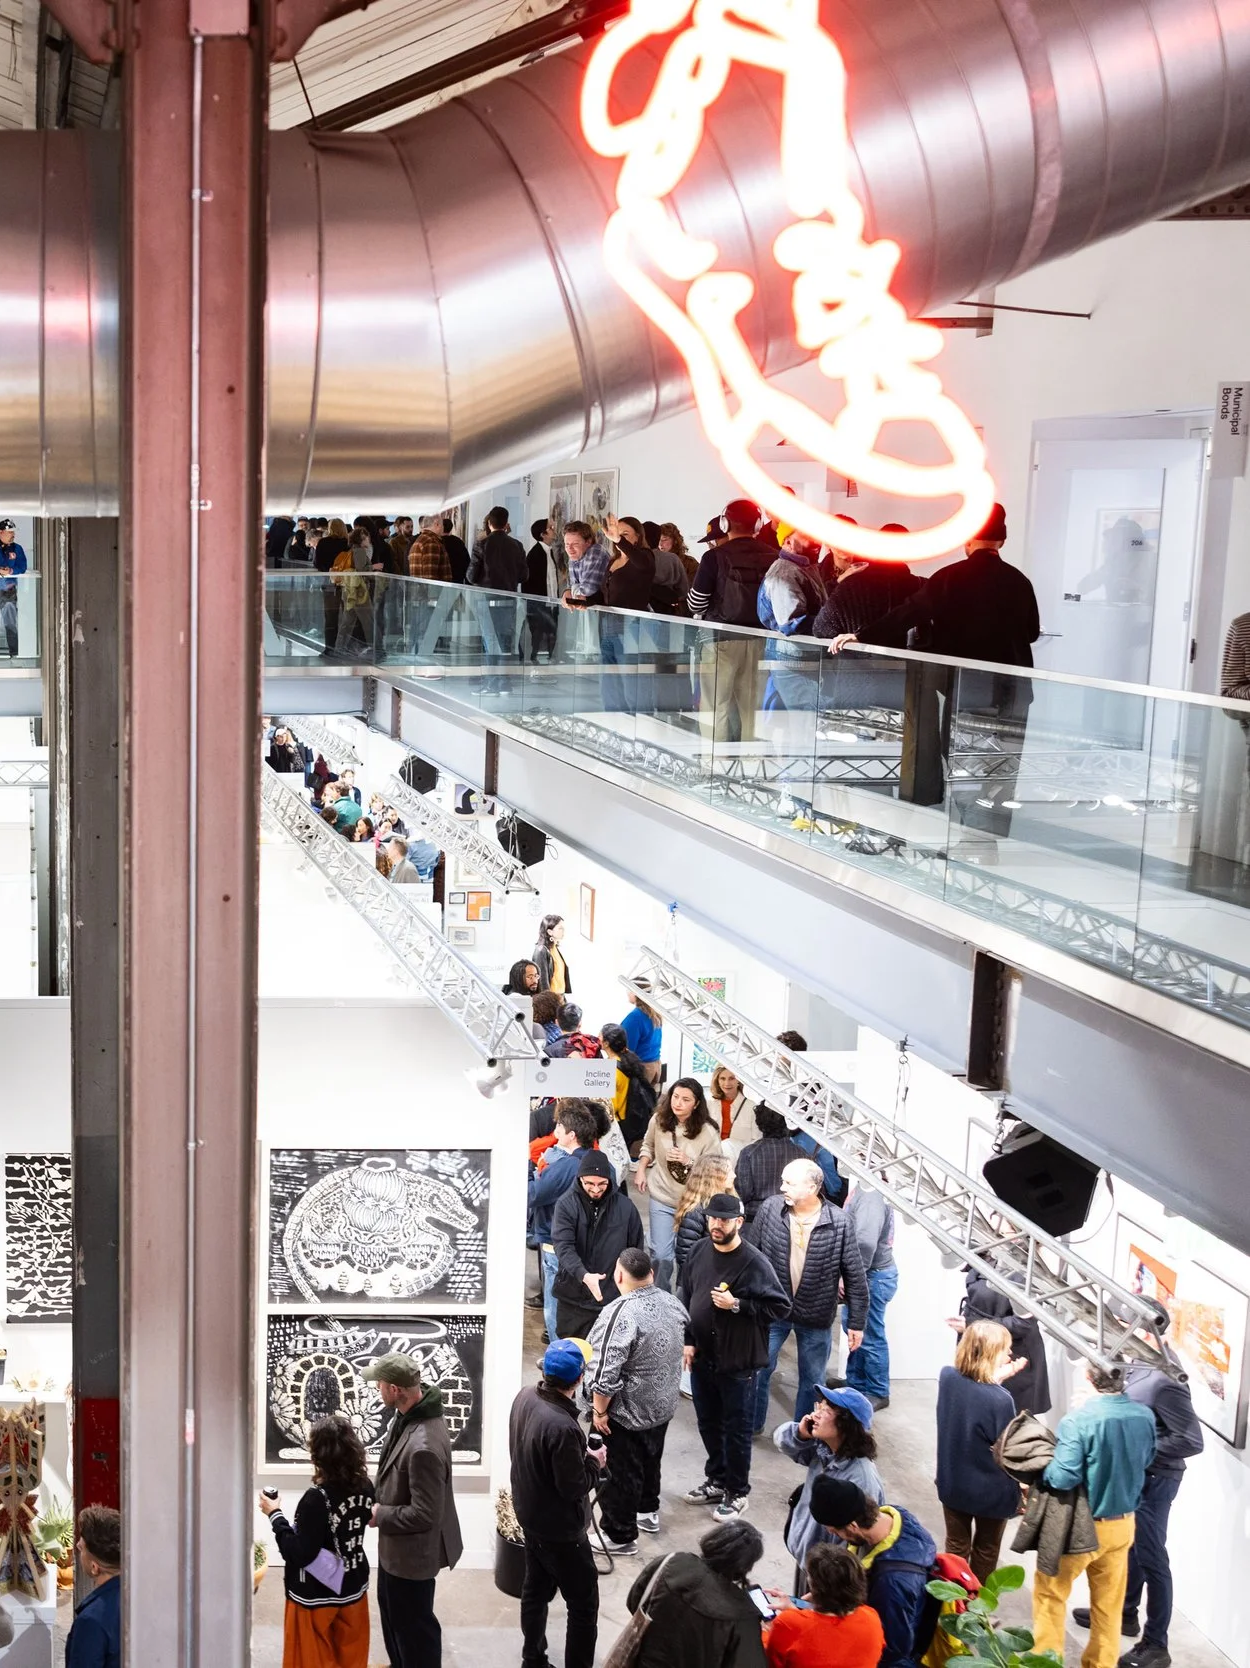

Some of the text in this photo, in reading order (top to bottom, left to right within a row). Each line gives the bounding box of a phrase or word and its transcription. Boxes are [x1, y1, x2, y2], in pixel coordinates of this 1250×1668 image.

[1220, 387, 1232, 420] Bonds
[1229, 387, 1243, 436] Municipal
[584, 1079, 610, 1088] Gallery
[586, 1070, 610, 1078] Incline
[332, 1494, 372, 1533] MEXIC
[349, 1517, 361, 1531] IS
